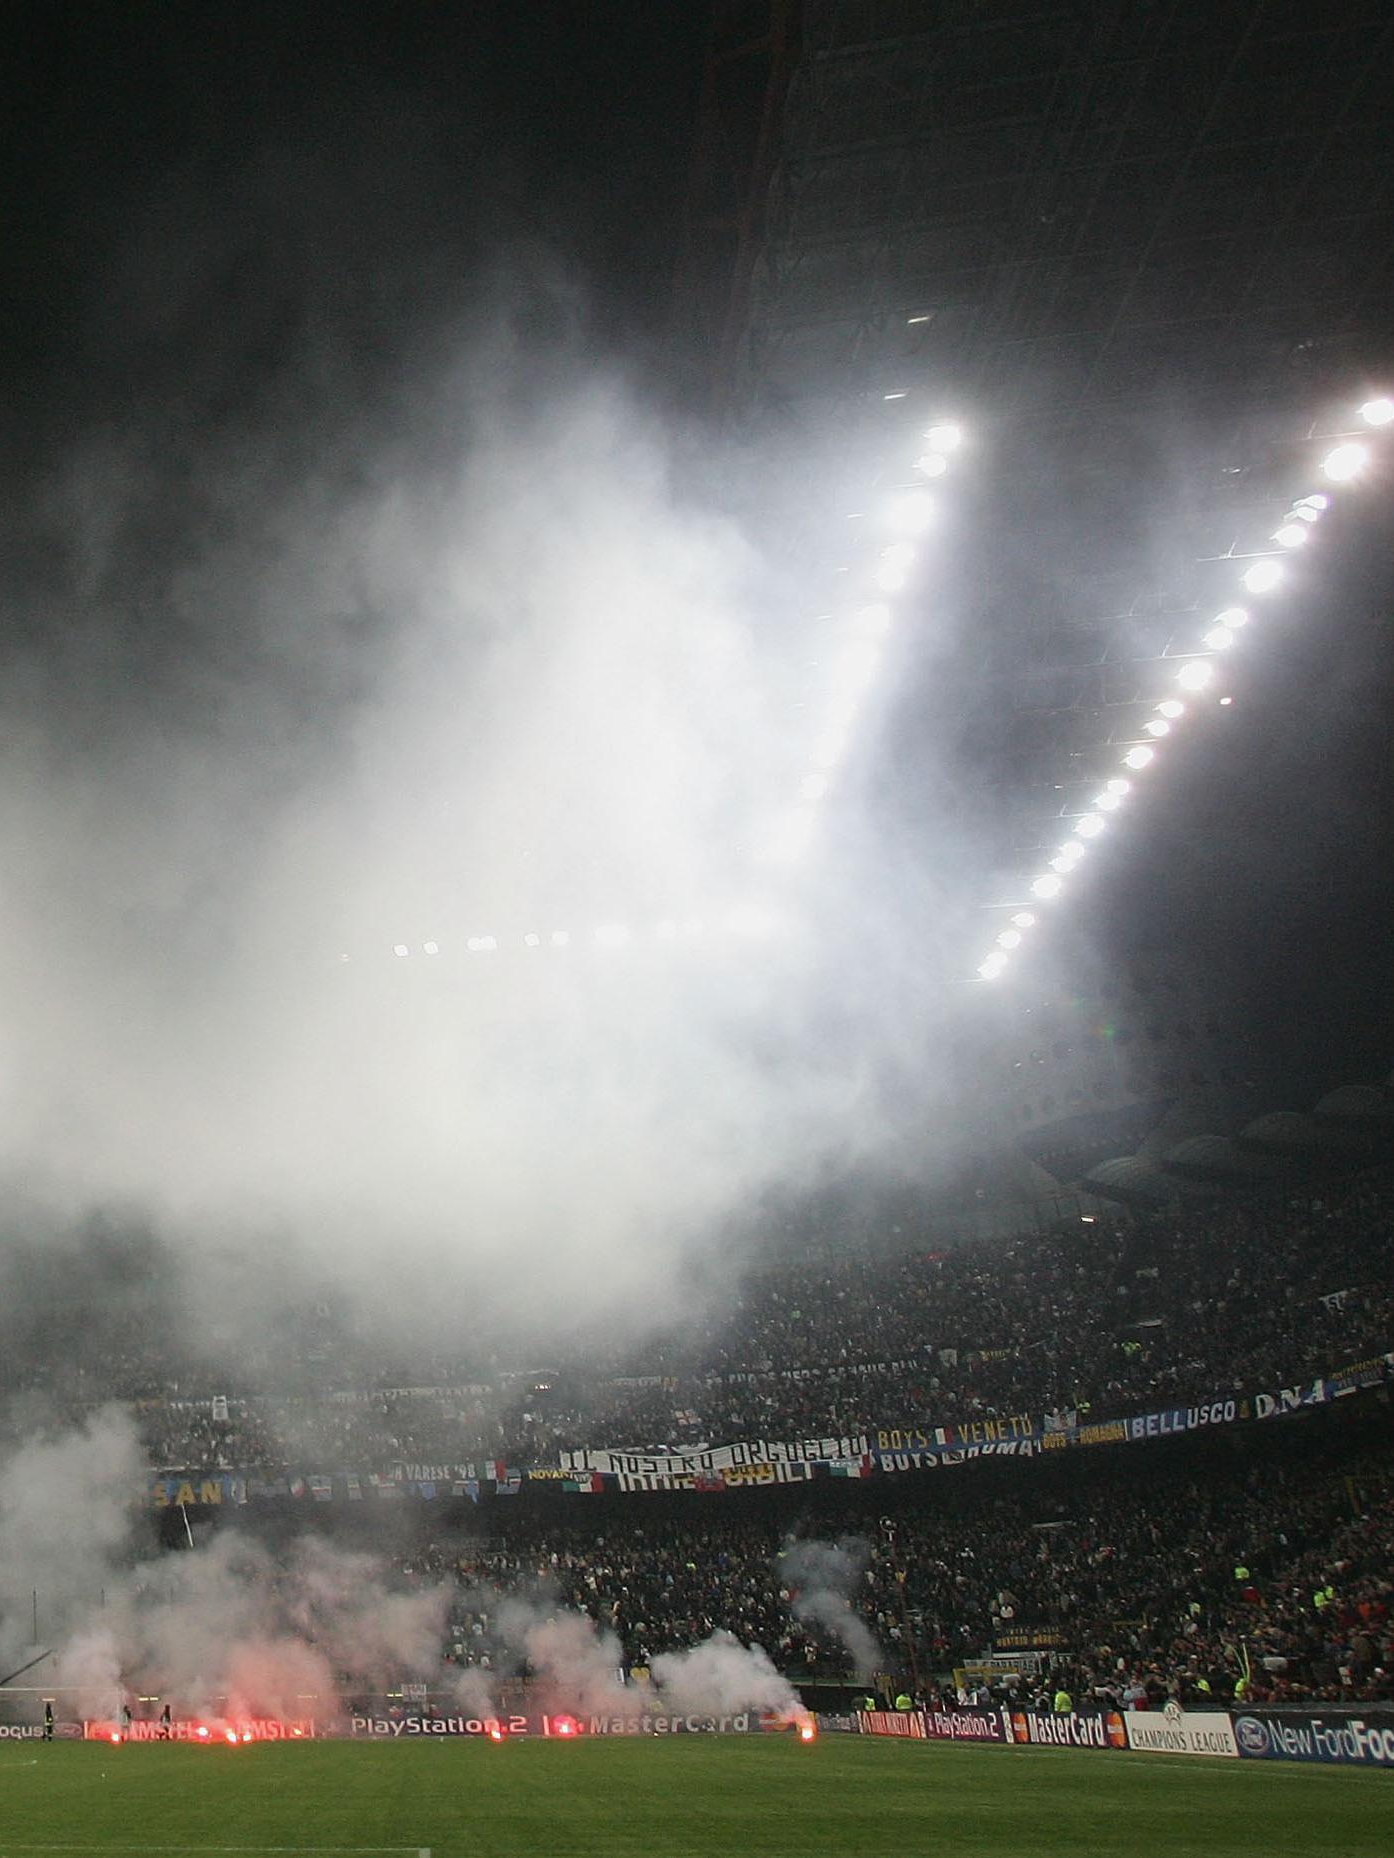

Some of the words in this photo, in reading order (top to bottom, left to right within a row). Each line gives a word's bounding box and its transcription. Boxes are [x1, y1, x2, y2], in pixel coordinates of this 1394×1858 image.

[878, 1428, 929, 1450] BOYS
[957, 1416, 1033, 1445] VENETO
[1132, 1400, 1236, 1440] BELLUSCO
[405, 1463, 451, 1480] VARESE
[351, 1717, 501, 1737] PlayStation
[591, 1712, 749, 1734] MasterCard
[934, 1712, 988, 1738] PlayStation
[1027, 1712, 1107, 1746] MasterCard
[1131, 1727, 1187, 1751] CHAMPIONS
[1189, 1730, 1233, 1753] LEAGUE
[1267, 1719, 1312, 1754] New
